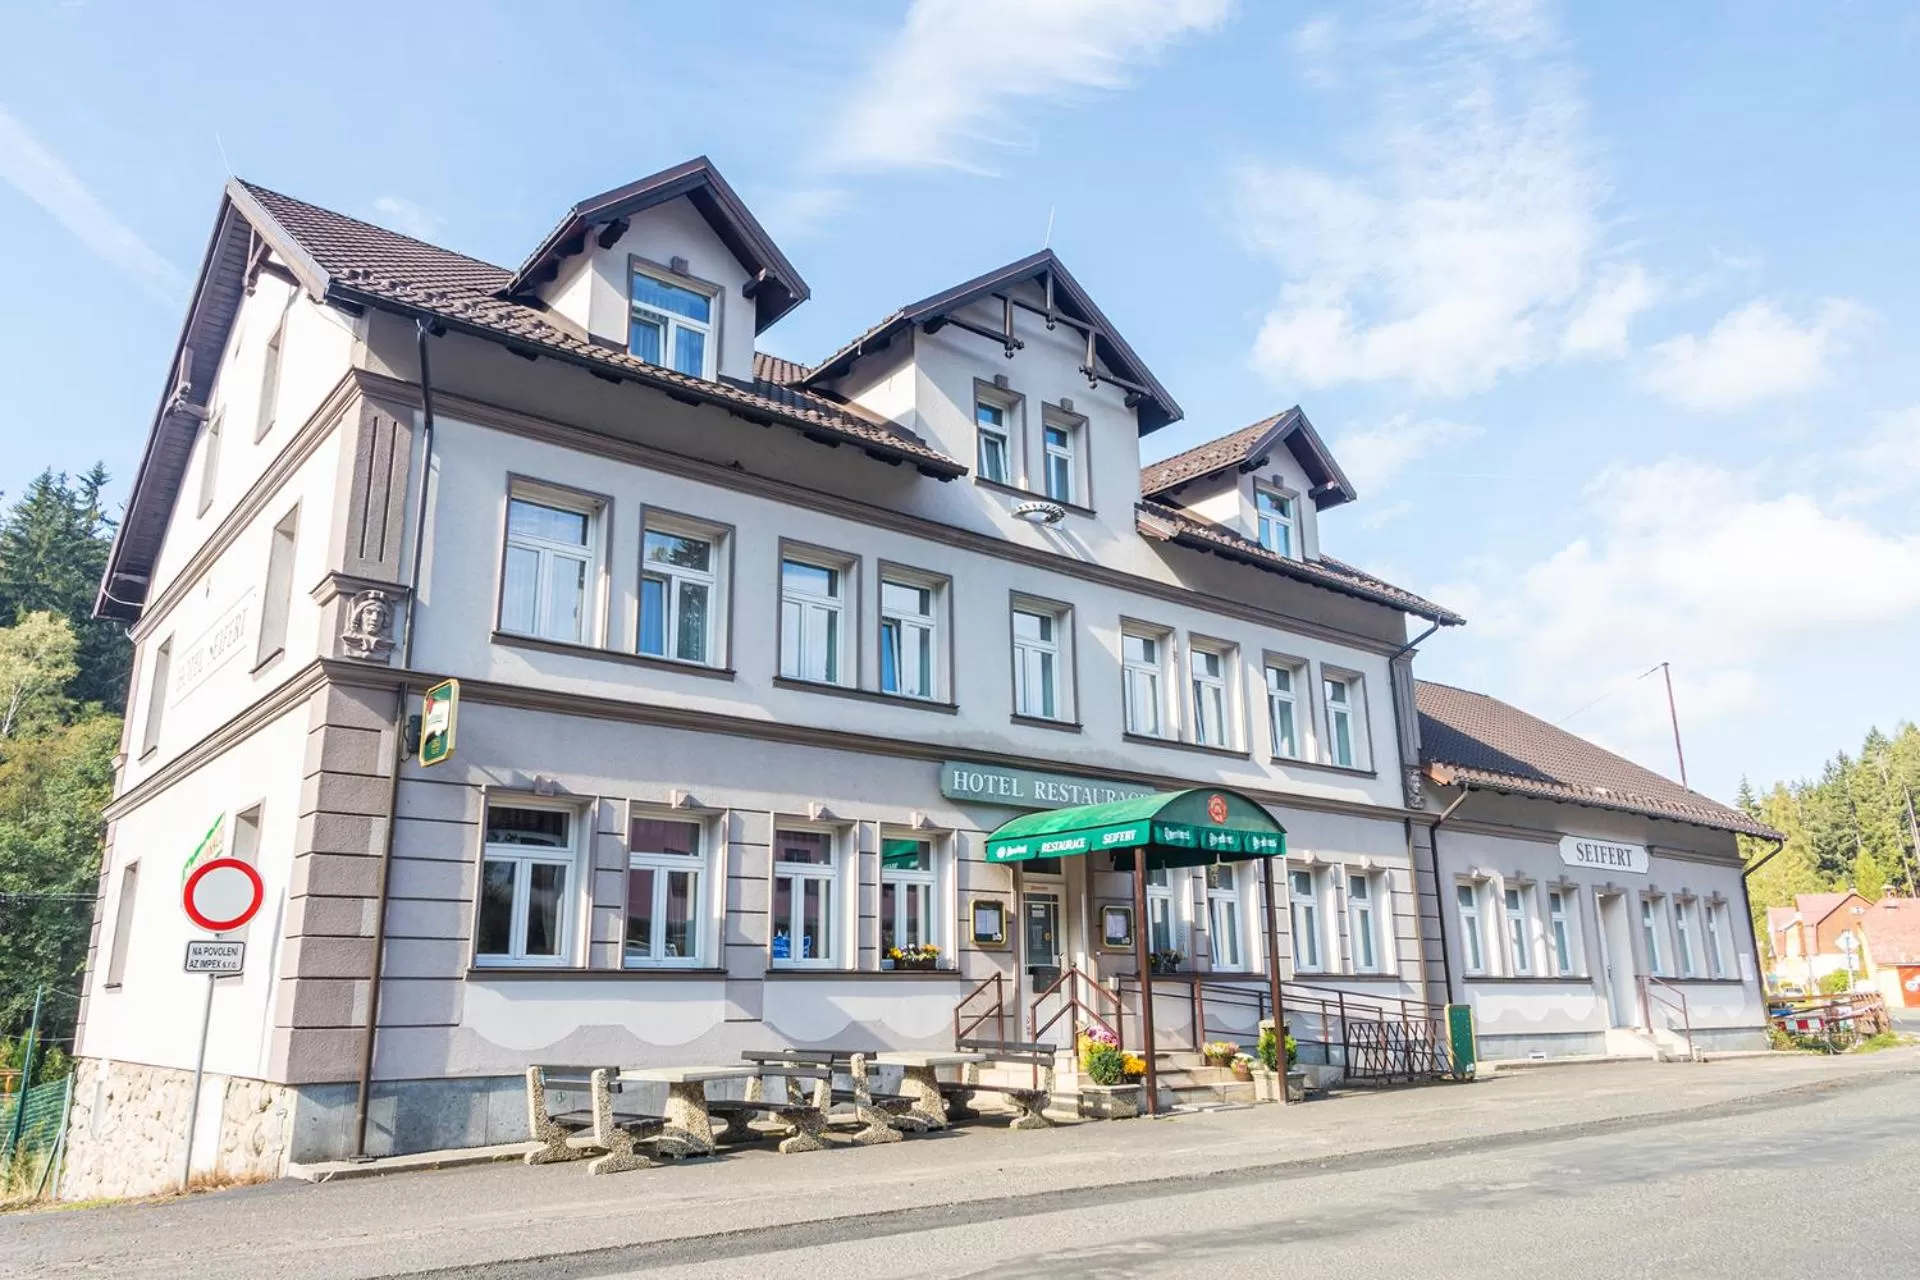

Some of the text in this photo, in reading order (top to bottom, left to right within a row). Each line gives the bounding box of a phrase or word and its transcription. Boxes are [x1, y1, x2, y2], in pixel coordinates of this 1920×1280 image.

[952, 770, 1150, 805] HOTEL RESTAUR
[1102, 829, 1137, 845] SEIFERT
[1576, 842, 1632, 867] SEIFERT
[192, 947, 202, 956] NA
